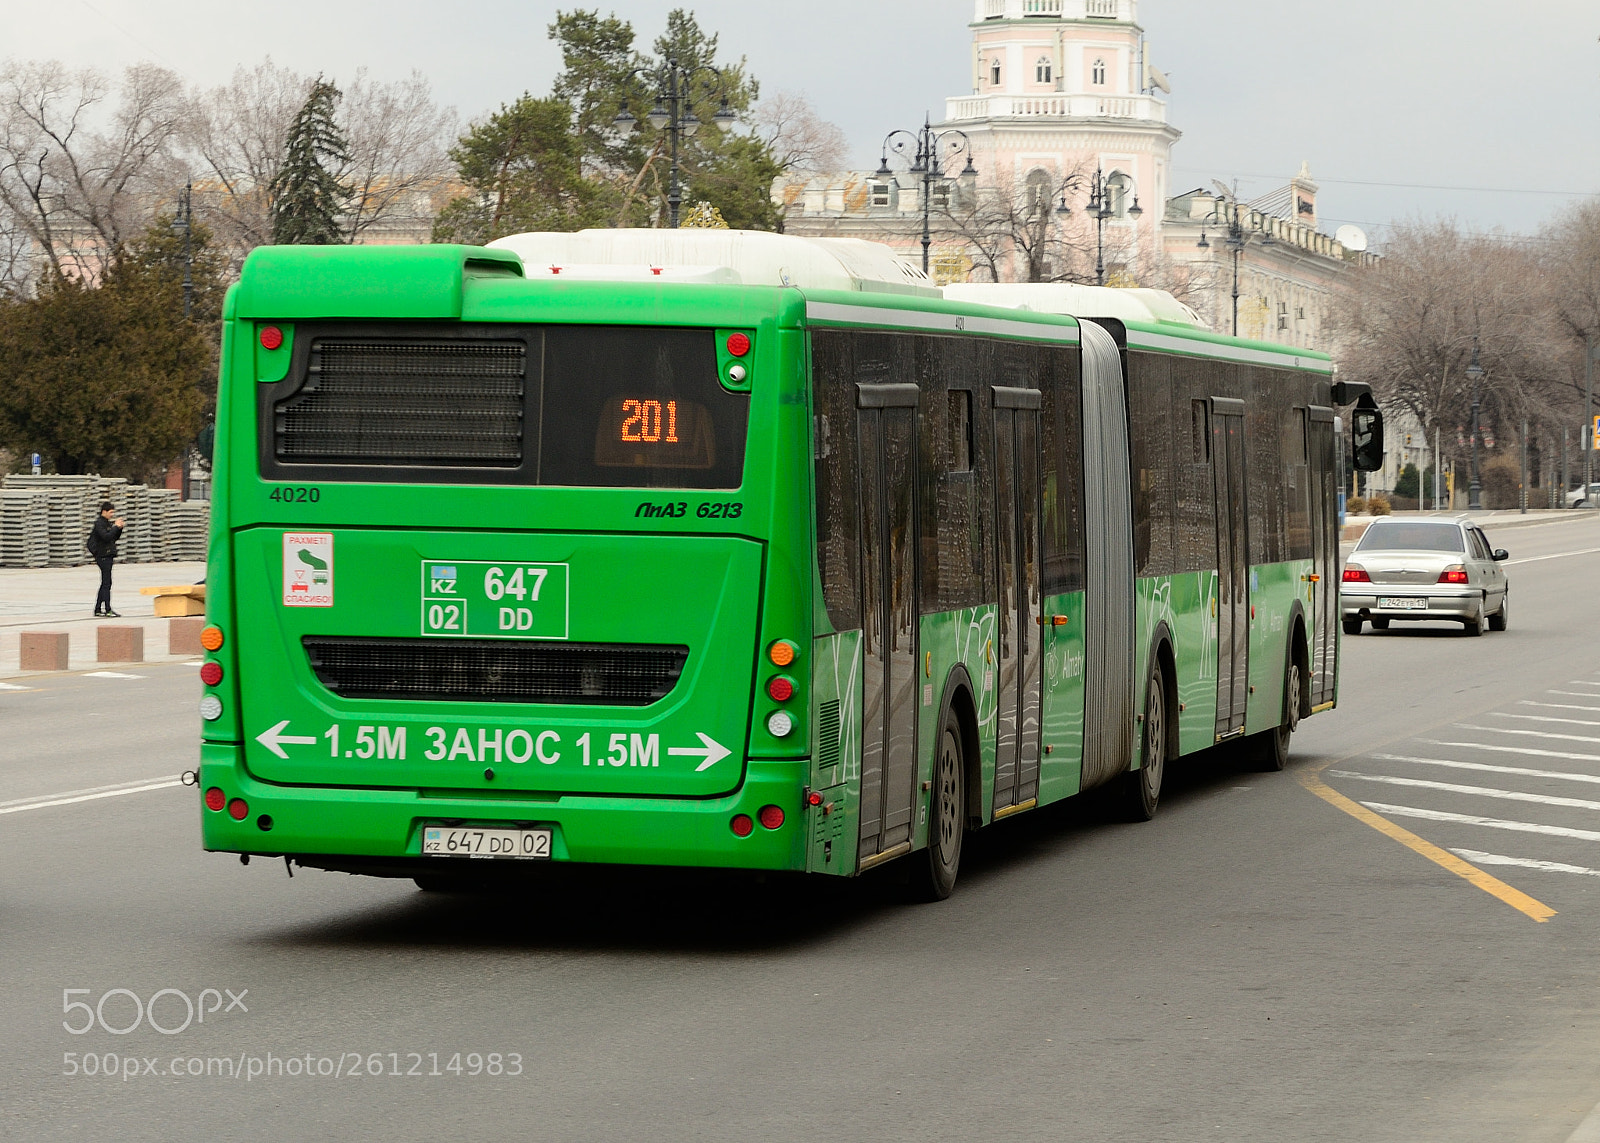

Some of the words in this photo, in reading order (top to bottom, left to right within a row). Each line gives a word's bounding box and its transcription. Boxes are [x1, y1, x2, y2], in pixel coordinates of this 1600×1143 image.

[621, 399, 678, 442] 201
[269, 487, 320, 503] 4020
[696, 502, 743, 518] 6213
[431, 579, 457, 594] KZ
[484, 566, 548, 601] 647
[428, 604, 460, 630] 02
[499, 607, 533, 631] DD
[424, 726, 561, 765] ЗАНОС
[425, 842, 440, 851] KZ
[447, 831, 484, 852] 647
[490, 837, 514, 853] DD
[523, 834, 548, 855] 02
